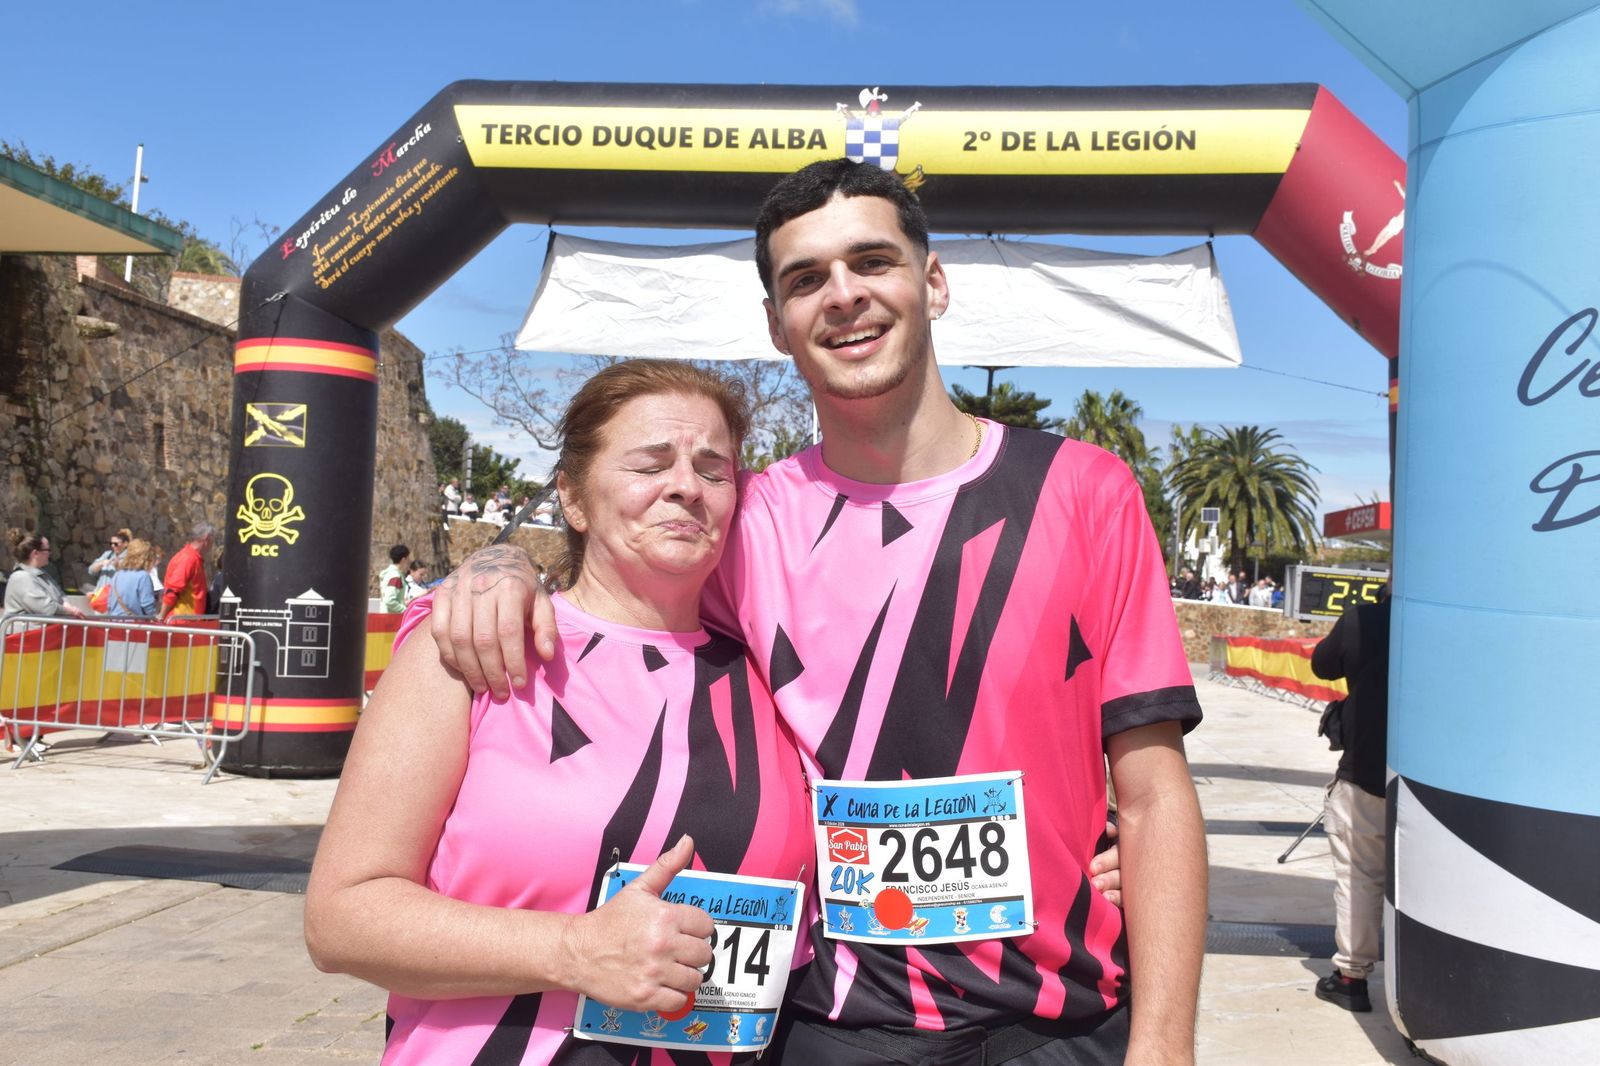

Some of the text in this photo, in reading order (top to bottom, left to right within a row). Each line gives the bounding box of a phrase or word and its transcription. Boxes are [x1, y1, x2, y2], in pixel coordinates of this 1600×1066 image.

[481, 124, 828, 150] TERCIO DUQUE DE ALBA
[963, 124, 1196, 151] 2º DE LA LEGIÓN
[280, 122, 432, 260] Espíritu de Marcha
[339, 224, 352, 239] un
[348, 186, 396, 228] Legionario
[395, 170, 413, 189] dirá
[412, 158, 428, 177] que
[341, 260, 350, 273] el
[349, 239, 377, 266] cuerpo
[376, 225, 393, 243] más
[392, 208, 415, 228] veloz
[412, 200, 426, 216] y
[420, 166, 459, 204] resistente
[363, 213, 387, 235] hasta
[251, 544, 279, 557] DCC
[822, 792, 839, 818] X
[925, 793, 976, 818] LEGIÓN
[828, 838, 868, 852] San Pablo
[879, 822, 1009, 882] 2648
[830, 865, 875, 896] 20K
[940, 880, 970, 893] JESÚS
[725, 894, 769, 918] LEGIÓN
